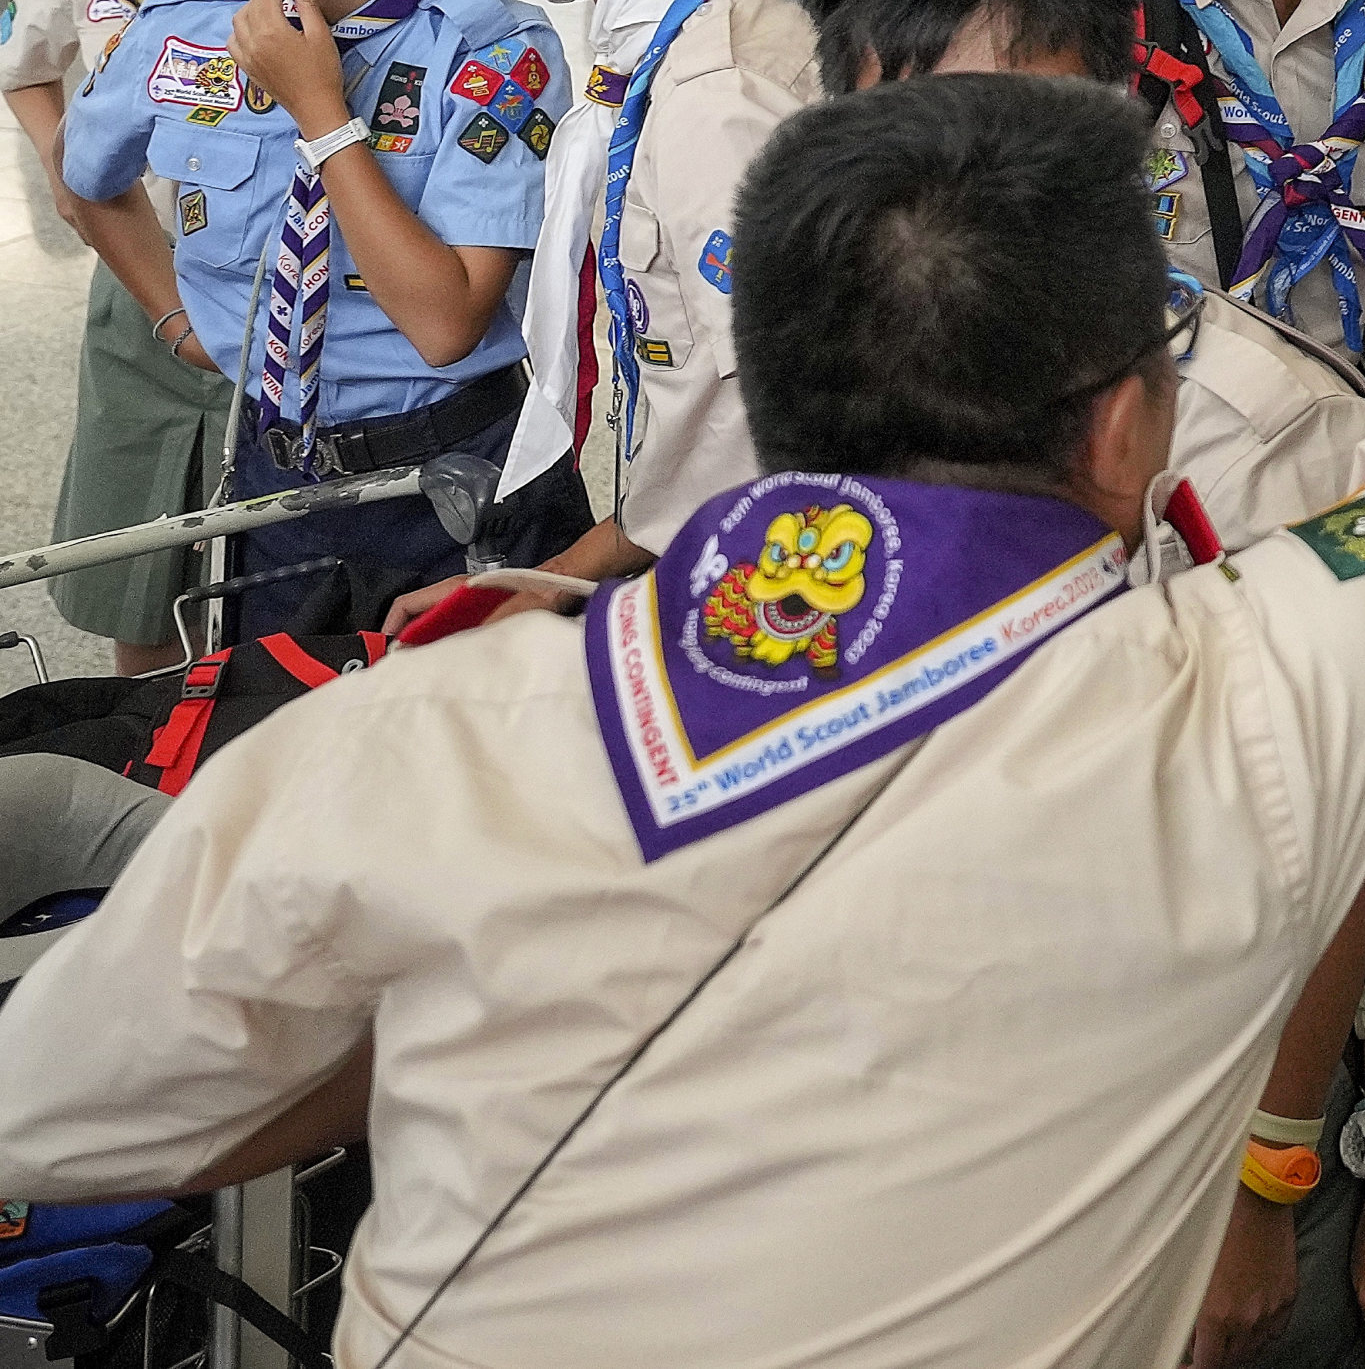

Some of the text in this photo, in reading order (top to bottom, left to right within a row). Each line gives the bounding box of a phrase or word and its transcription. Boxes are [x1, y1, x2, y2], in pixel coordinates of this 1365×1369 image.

[622, 648, 680, 788] CONTINGENT
[713, 741, 793, 794] World
[786, 702, 871, 756] Scout
[874, 635, 1000, 718] Jamboree
